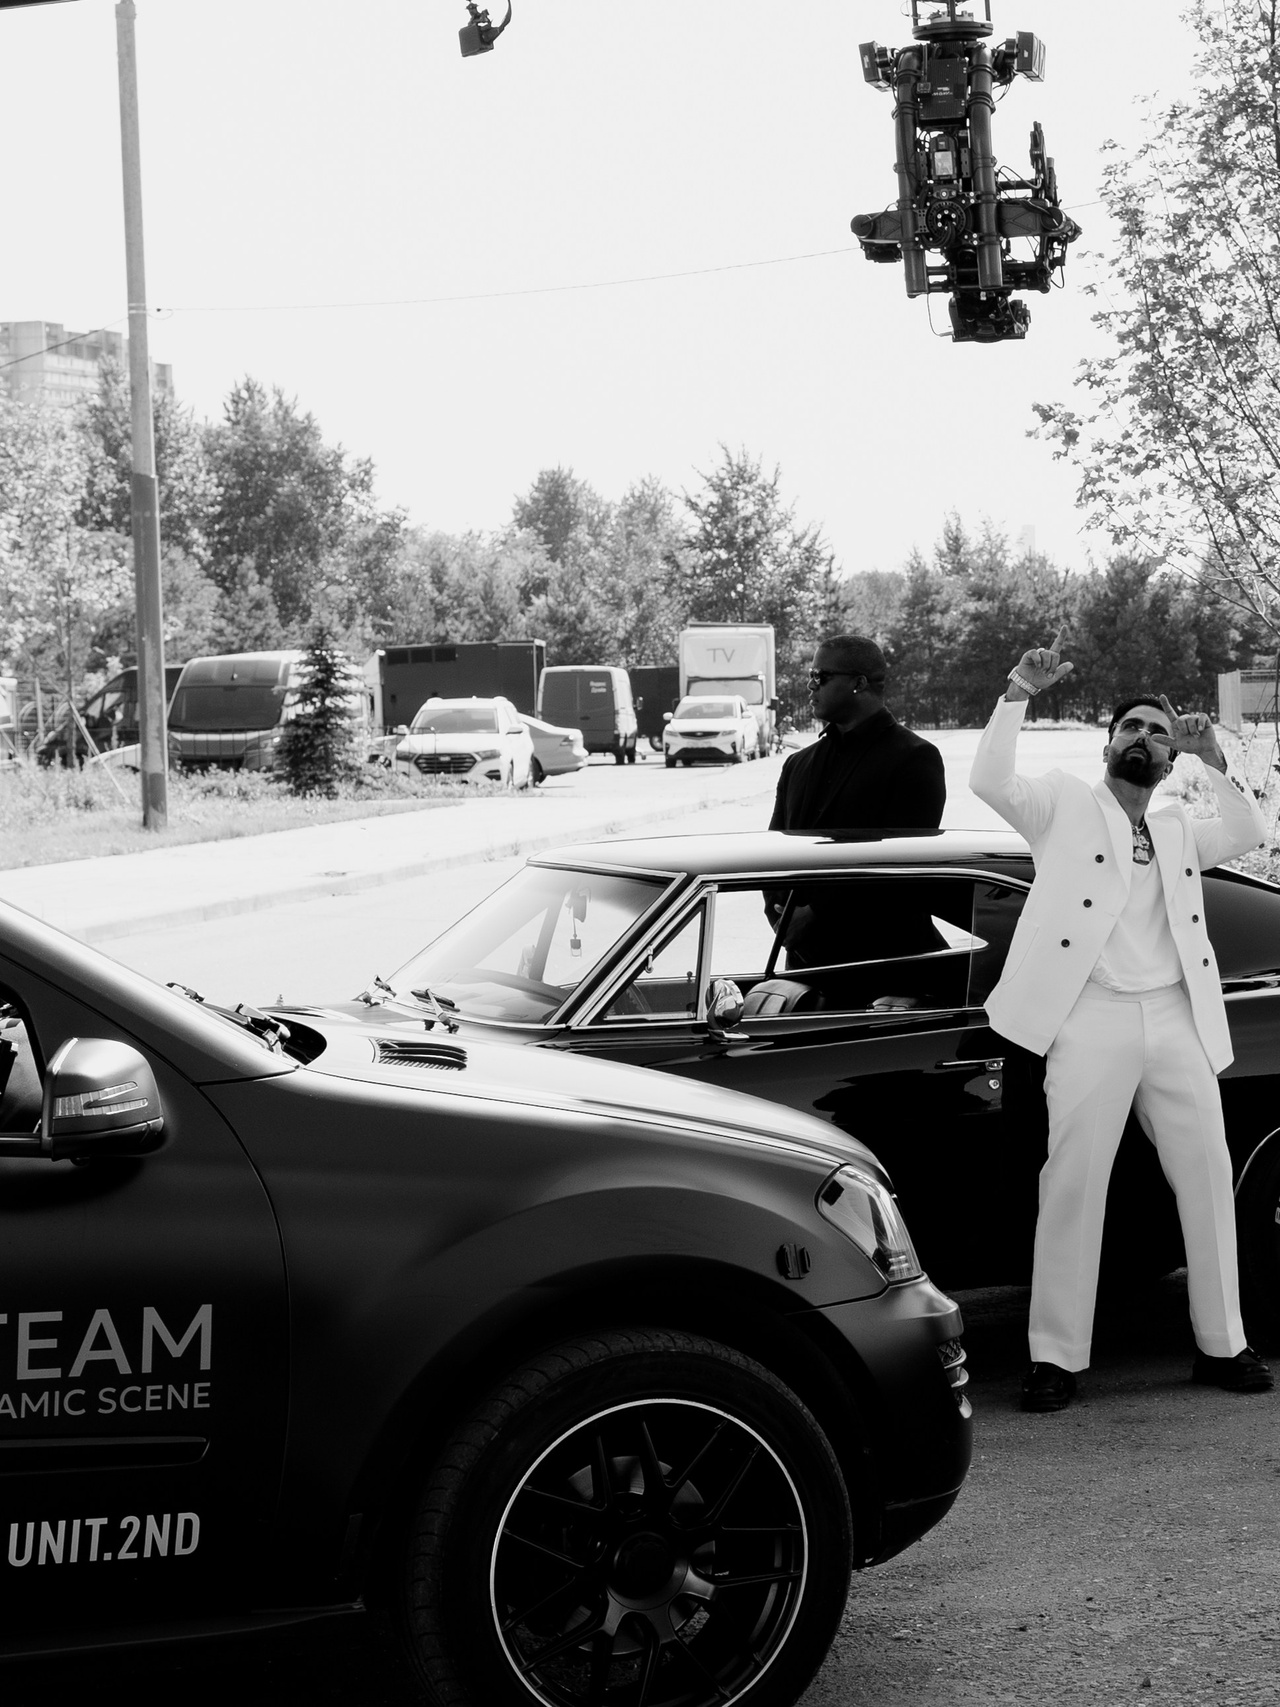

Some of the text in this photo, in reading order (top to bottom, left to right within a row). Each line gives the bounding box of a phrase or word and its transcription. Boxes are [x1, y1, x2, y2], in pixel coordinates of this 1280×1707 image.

[706, 647, 736, 663] TV
[0, 1304, 213, 1380] EAM
[97, 1382, 211, 1414] SCENE
[7, 1512, 200, 1567] UNIT.2ND
